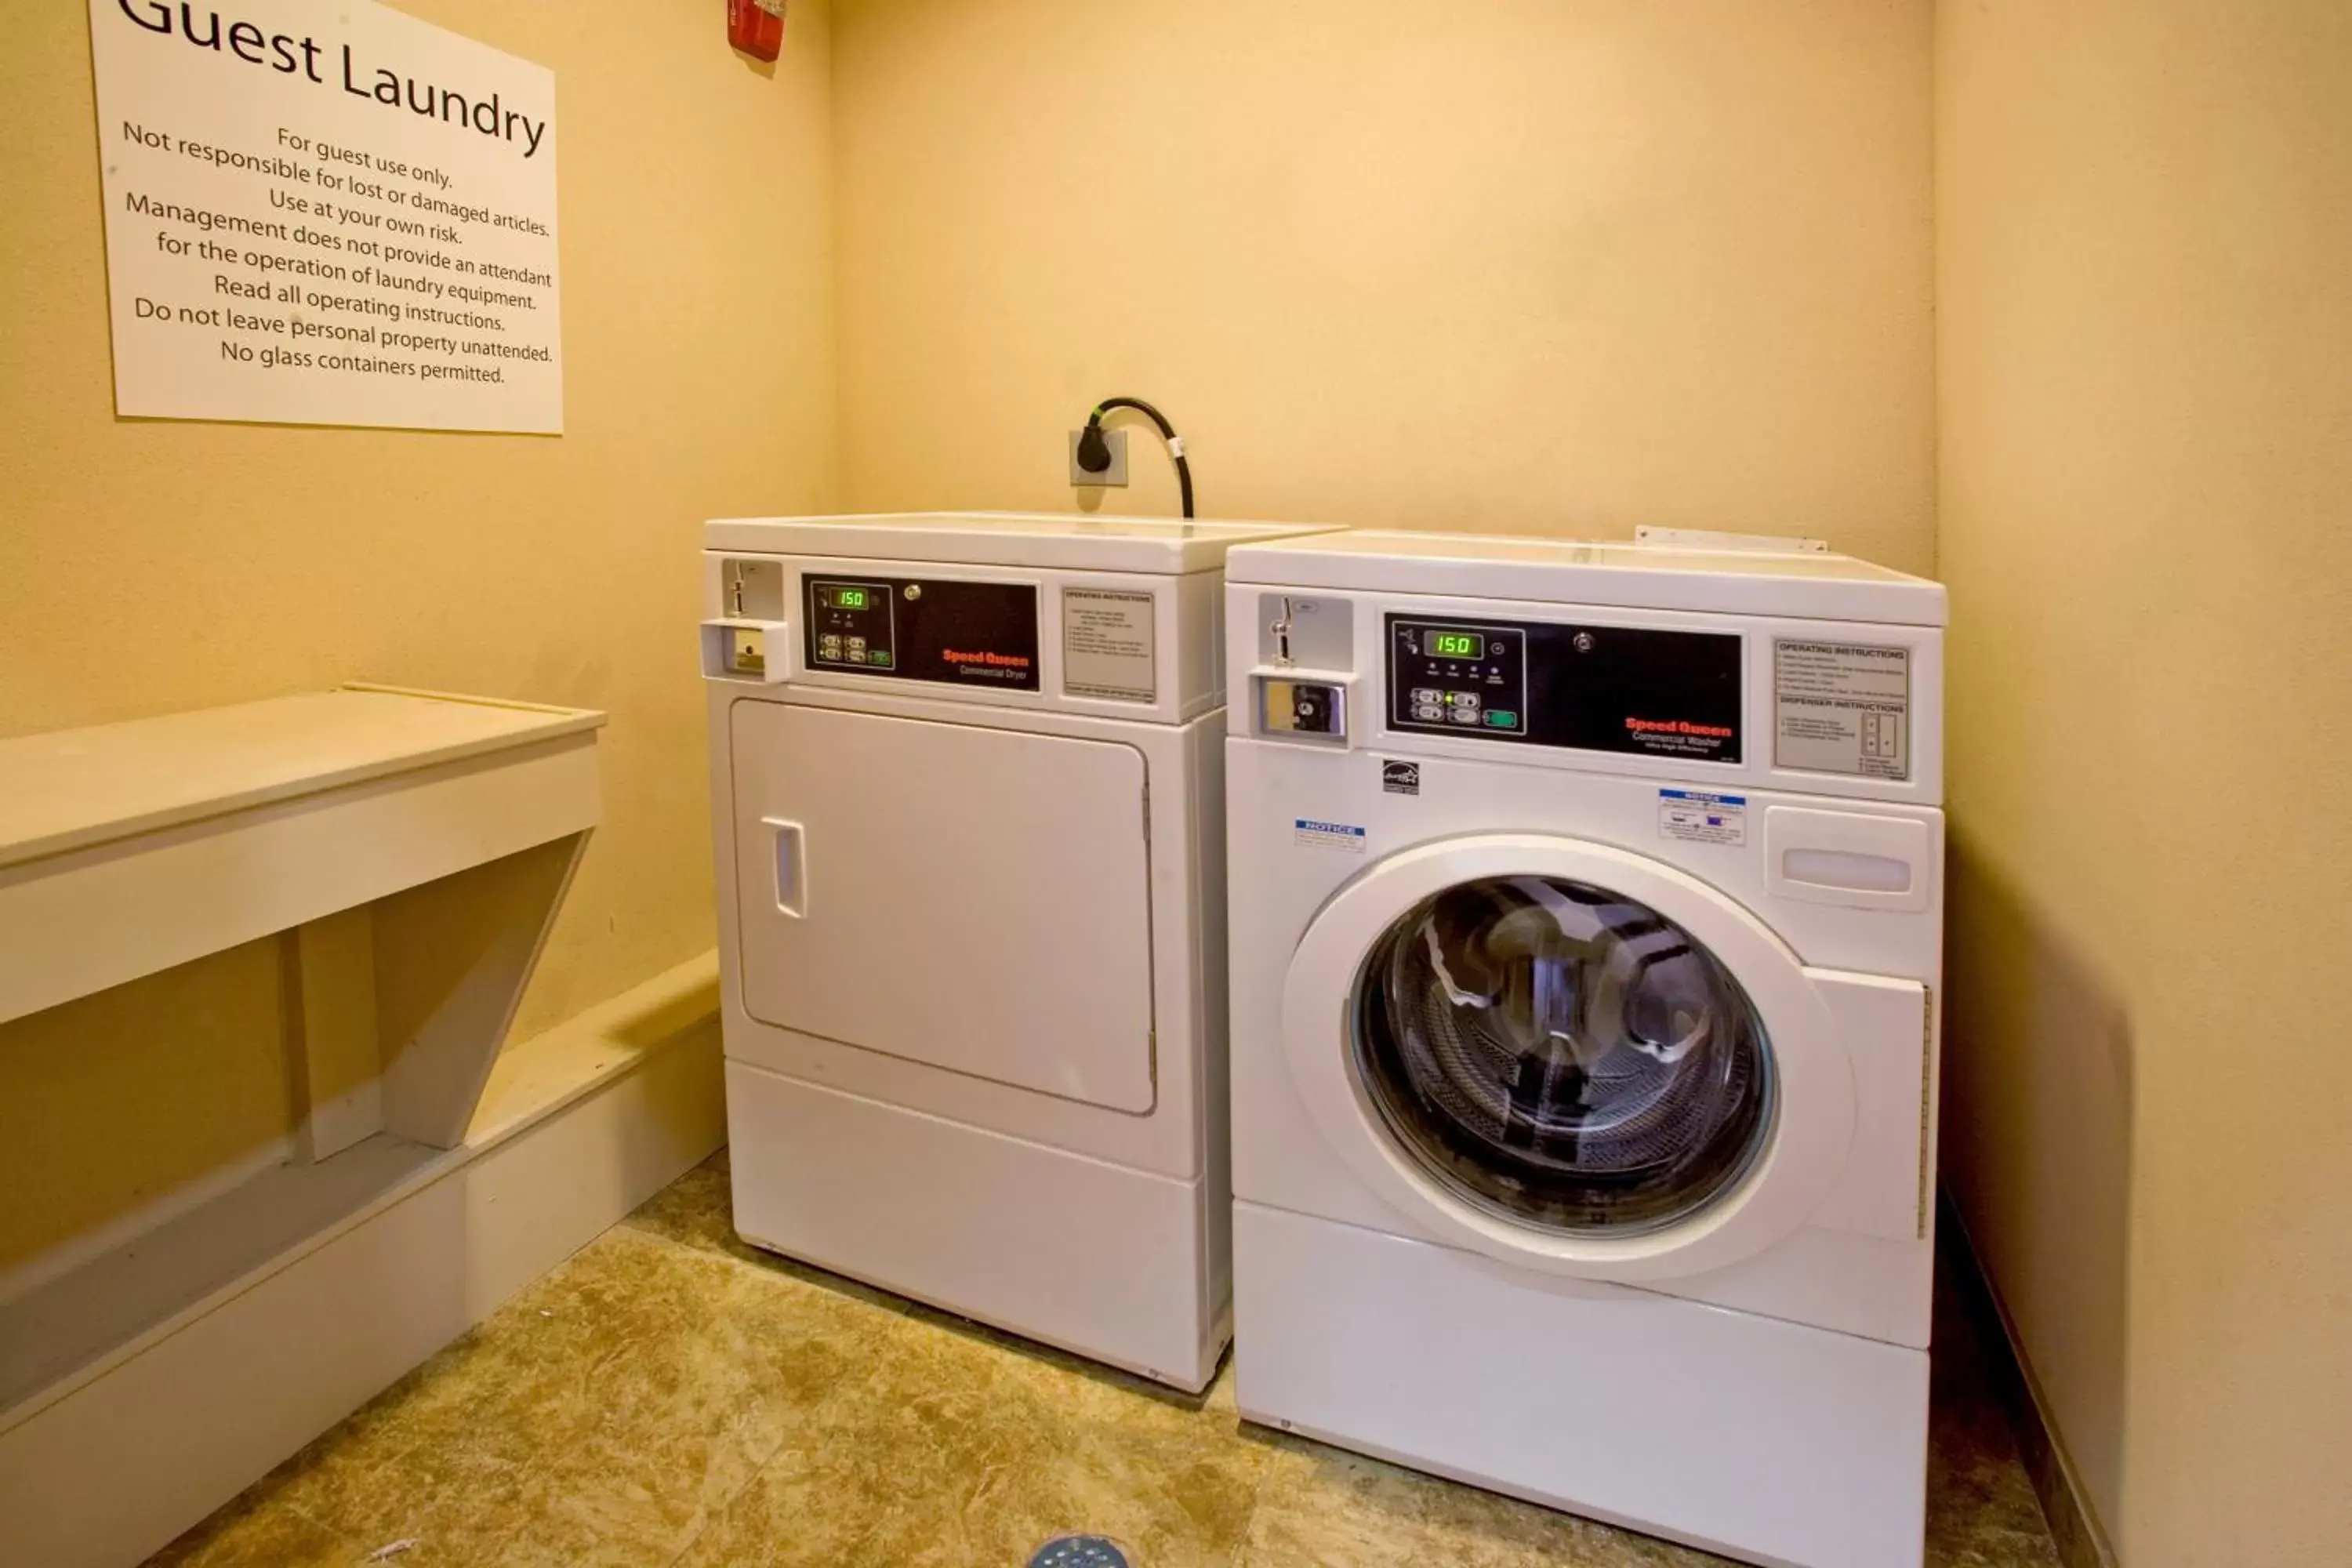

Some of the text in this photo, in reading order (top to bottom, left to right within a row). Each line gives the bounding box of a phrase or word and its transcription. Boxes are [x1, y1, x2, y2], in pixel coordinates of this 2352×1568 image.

[343, 44, 546, 159] Laundry
[124, 121, 549, 236] Not responsible for lost or damaged articles.
[278, 128, 452, 190] For guest use only.
[126, 192, 552, 288] Management does not provide an attendant
[270, 188, 462, 244] Use at your own risk.
[158, 231, 536, 310] for the operation of laundry equipment.
[136, 298, 553, 362] Do not leave personal property unattended.
[215, 274, 505, 332] Read all operating instructions.
[222, 341, 505, 383] No glass containers permitted.
[841, 592, 863, 606] 150
[942, 649, 1029, 666] Speed Queen
[1438, 635, 1471, 653] 150
[1779, 643, 1833, 655] OPERATING
[1835, 648, 1905, 660] INSTRUCTIONS
[1624, 717, 1733, 737] Speed Queen
